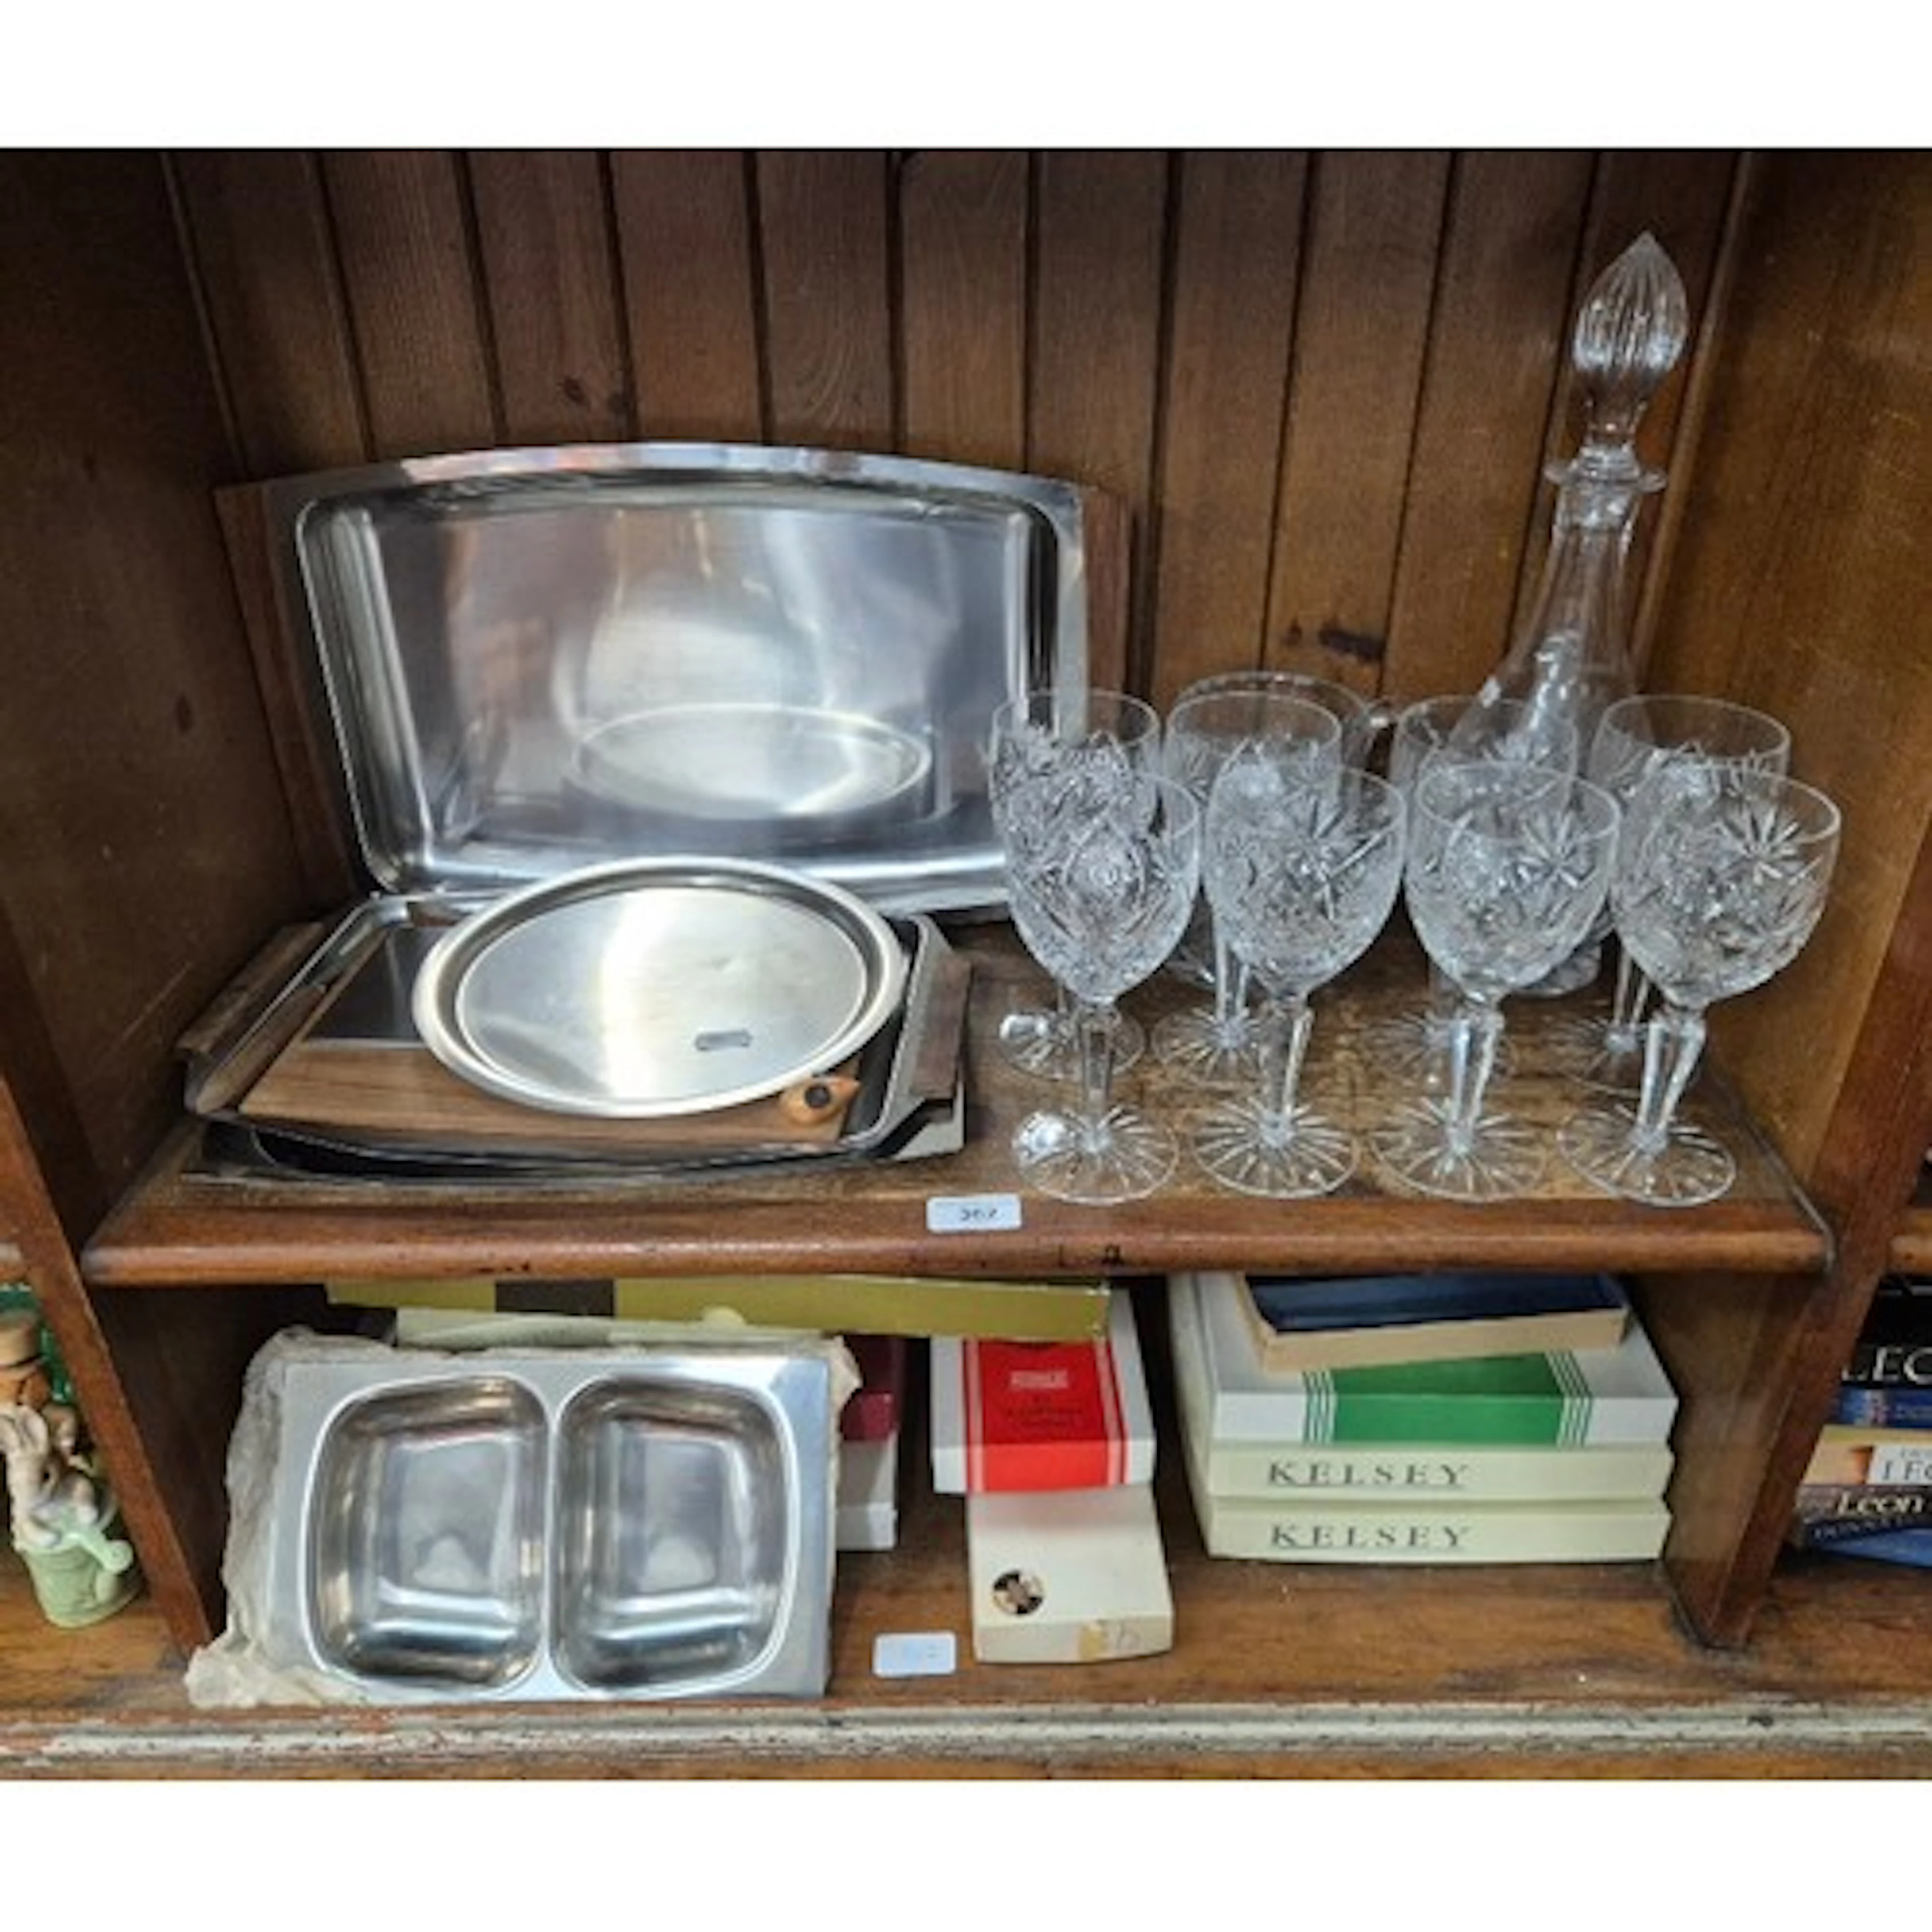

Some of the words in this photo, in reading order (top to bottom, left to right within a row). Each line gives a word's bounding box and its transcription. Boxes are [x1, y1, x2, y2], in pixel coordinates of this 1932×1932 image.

[1269, 1464, 1468, 1486] KELSEY
[1837, 1491, 1924, 1516] Leon
[1272, 1526, 1469, 1549] KELSEY
